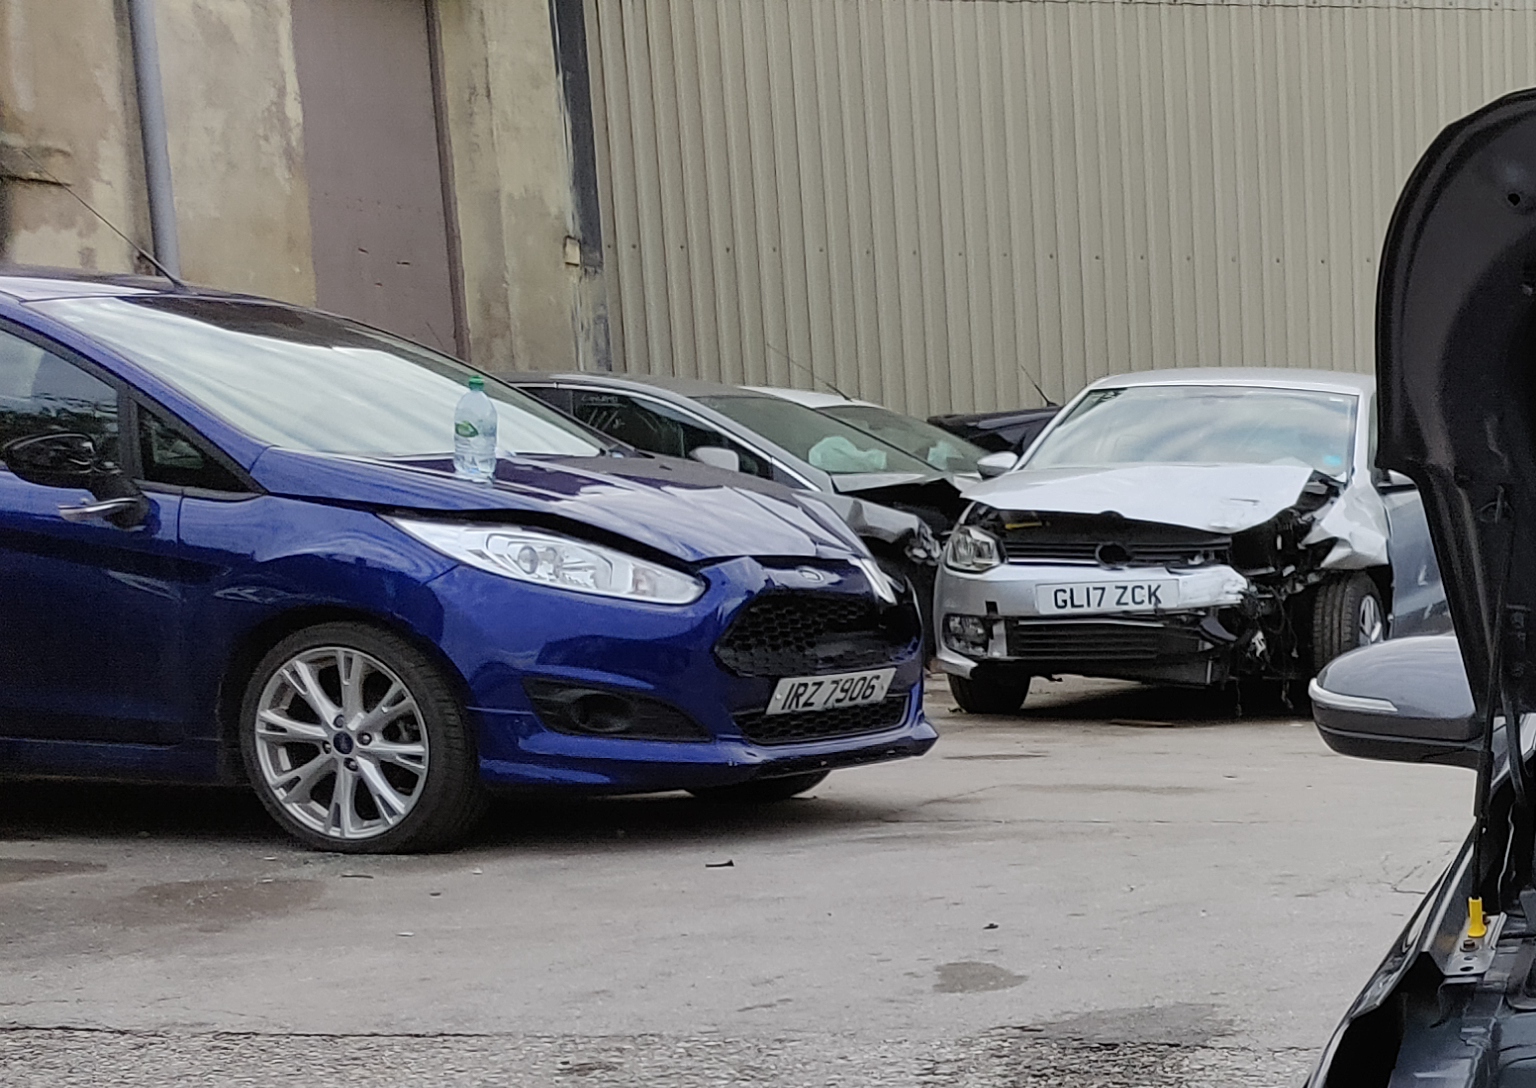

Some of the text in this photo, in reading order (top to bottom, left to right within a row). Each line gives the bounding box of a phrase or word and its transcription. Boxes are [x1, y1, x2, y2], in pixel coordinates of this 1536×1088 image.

[1053, 584, 1162, 609] GL17 ZCK
[781, 674, 881, 711] IRZ 7906
